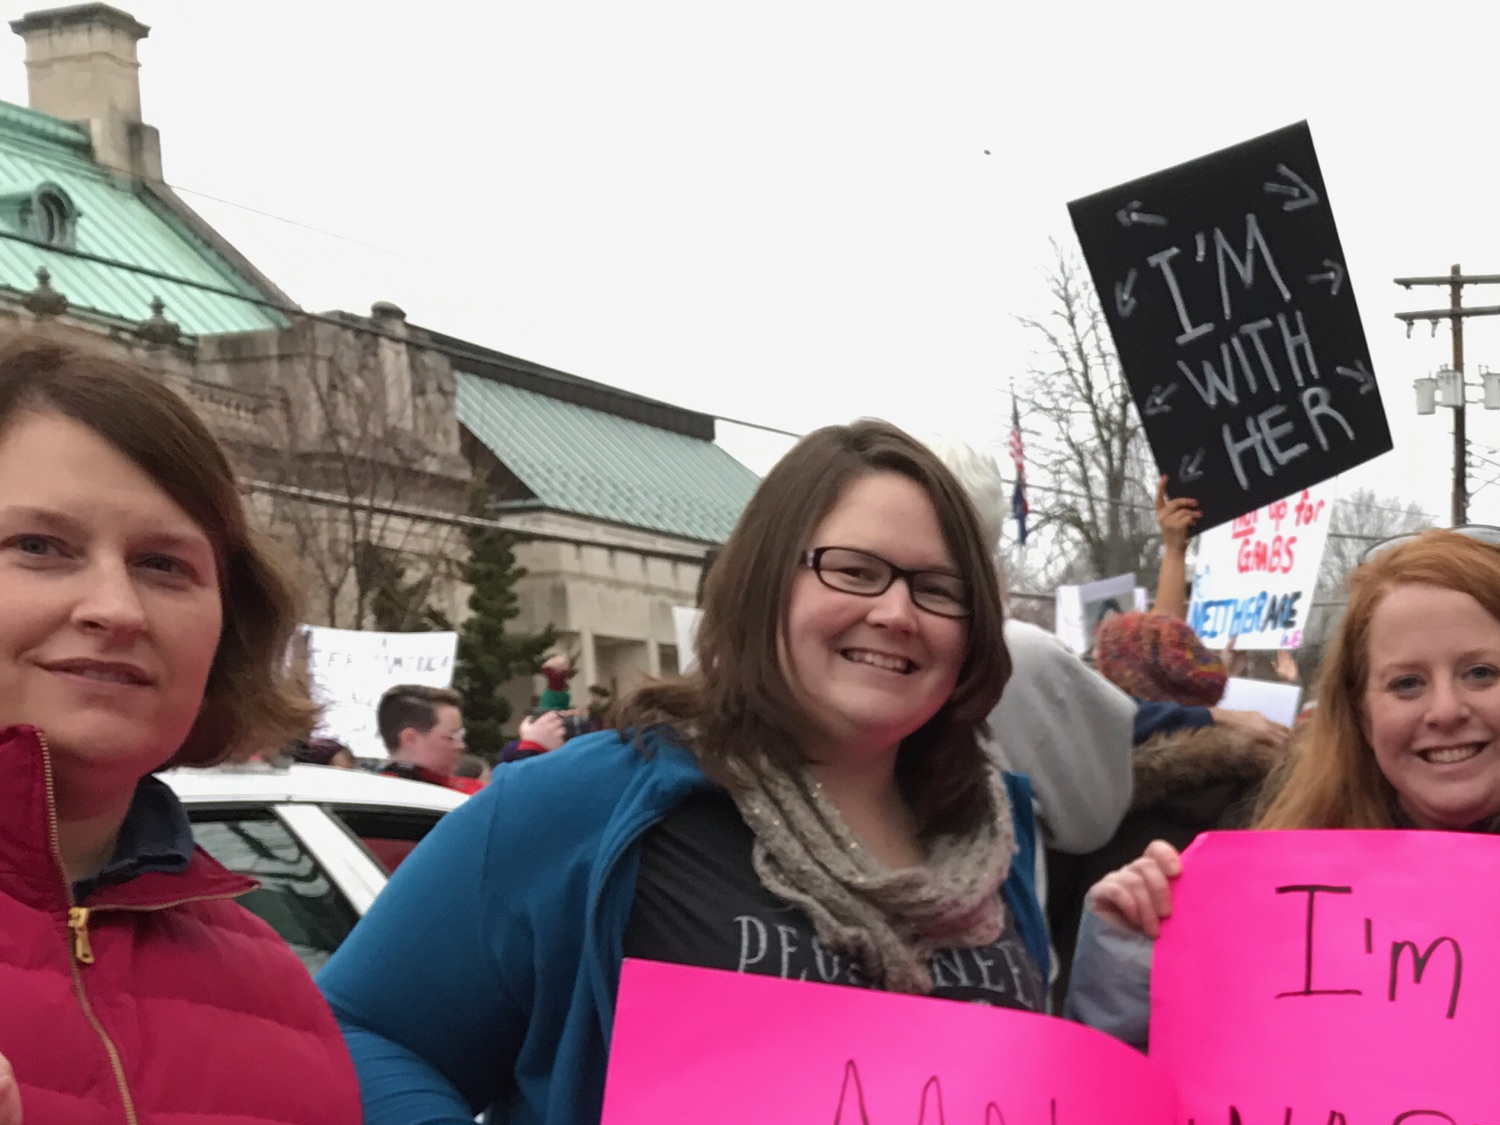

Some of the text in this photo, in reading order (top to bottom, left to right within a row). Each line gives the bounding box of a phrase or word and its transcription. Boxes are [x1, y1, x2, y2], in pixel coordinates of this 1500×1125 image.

[1147, 212, 1292, 345] I'M
[1176, 310, 1319, 408] WITH
[1221, 386, 1355, 490] HER
